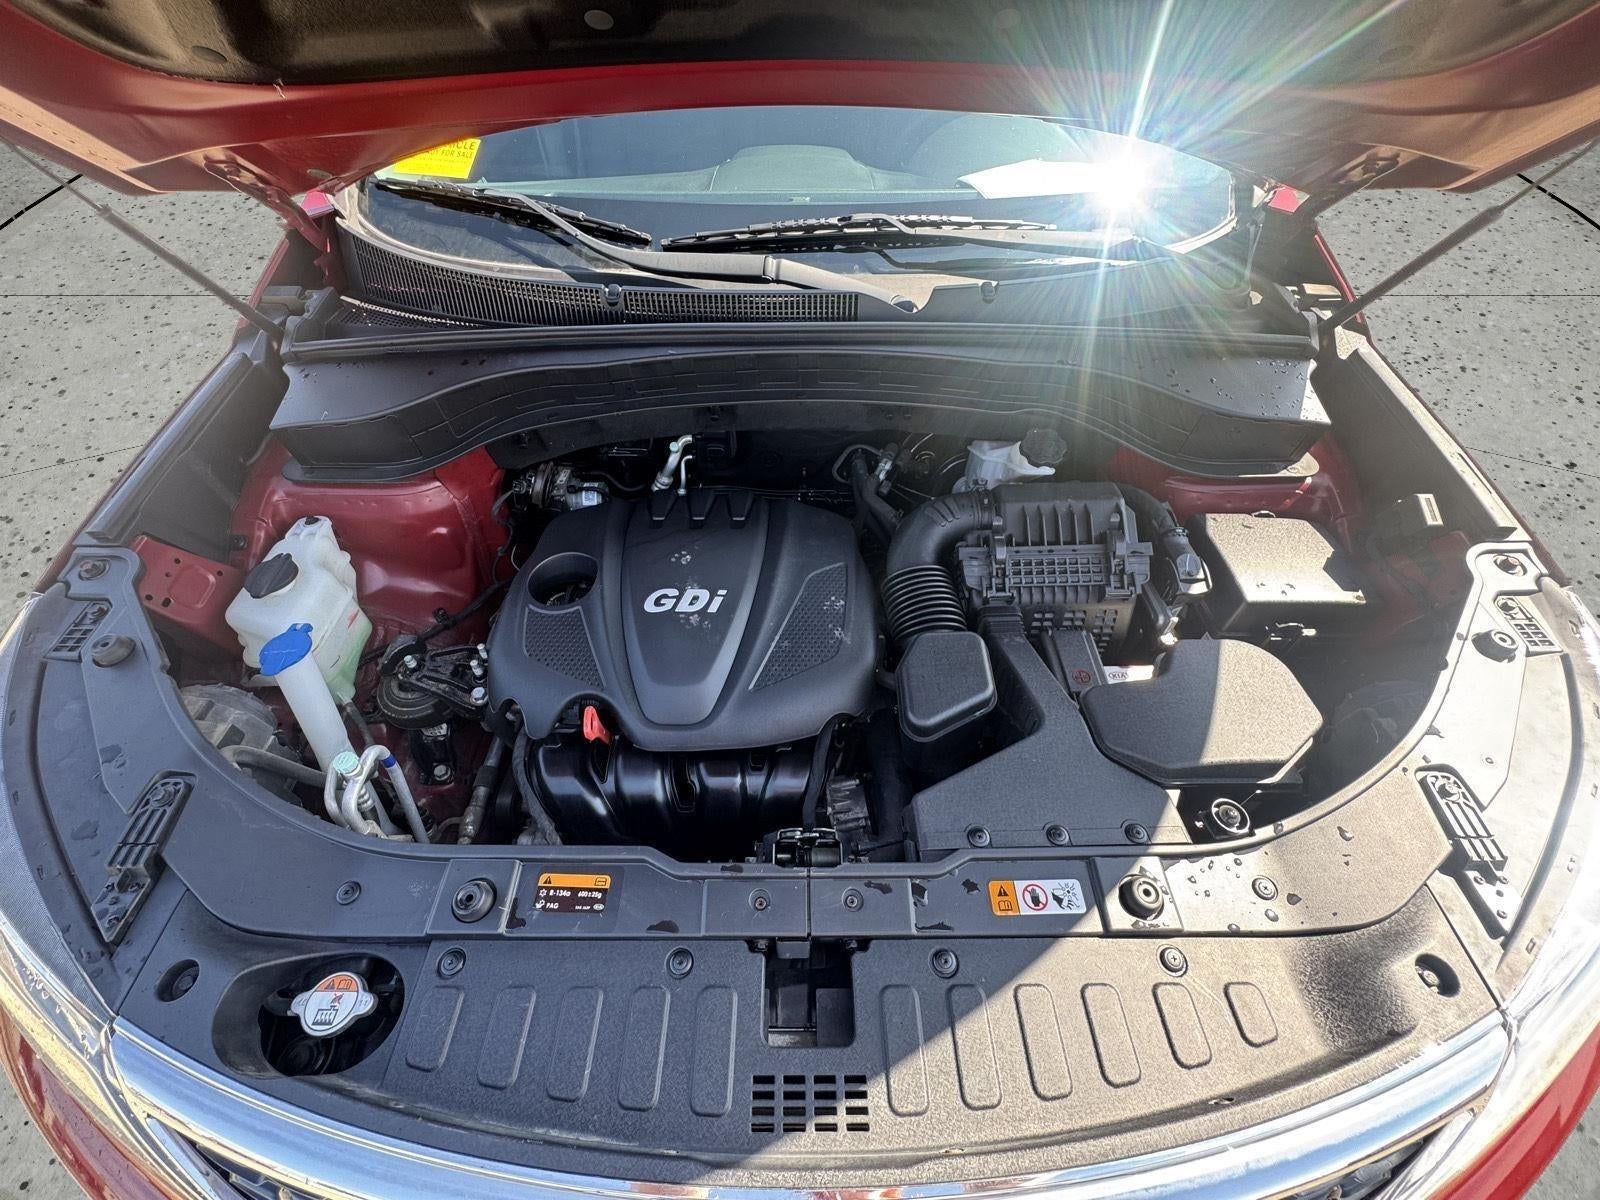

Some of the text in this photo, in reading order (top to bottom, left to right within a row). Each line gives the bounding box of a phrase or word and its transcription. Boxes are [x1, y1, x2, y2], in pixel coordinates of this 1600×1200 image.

[441, 149, 455, 157] FOR
[456, 150, 473, 159] SALE
[643, 588, 728, 613] GDi
